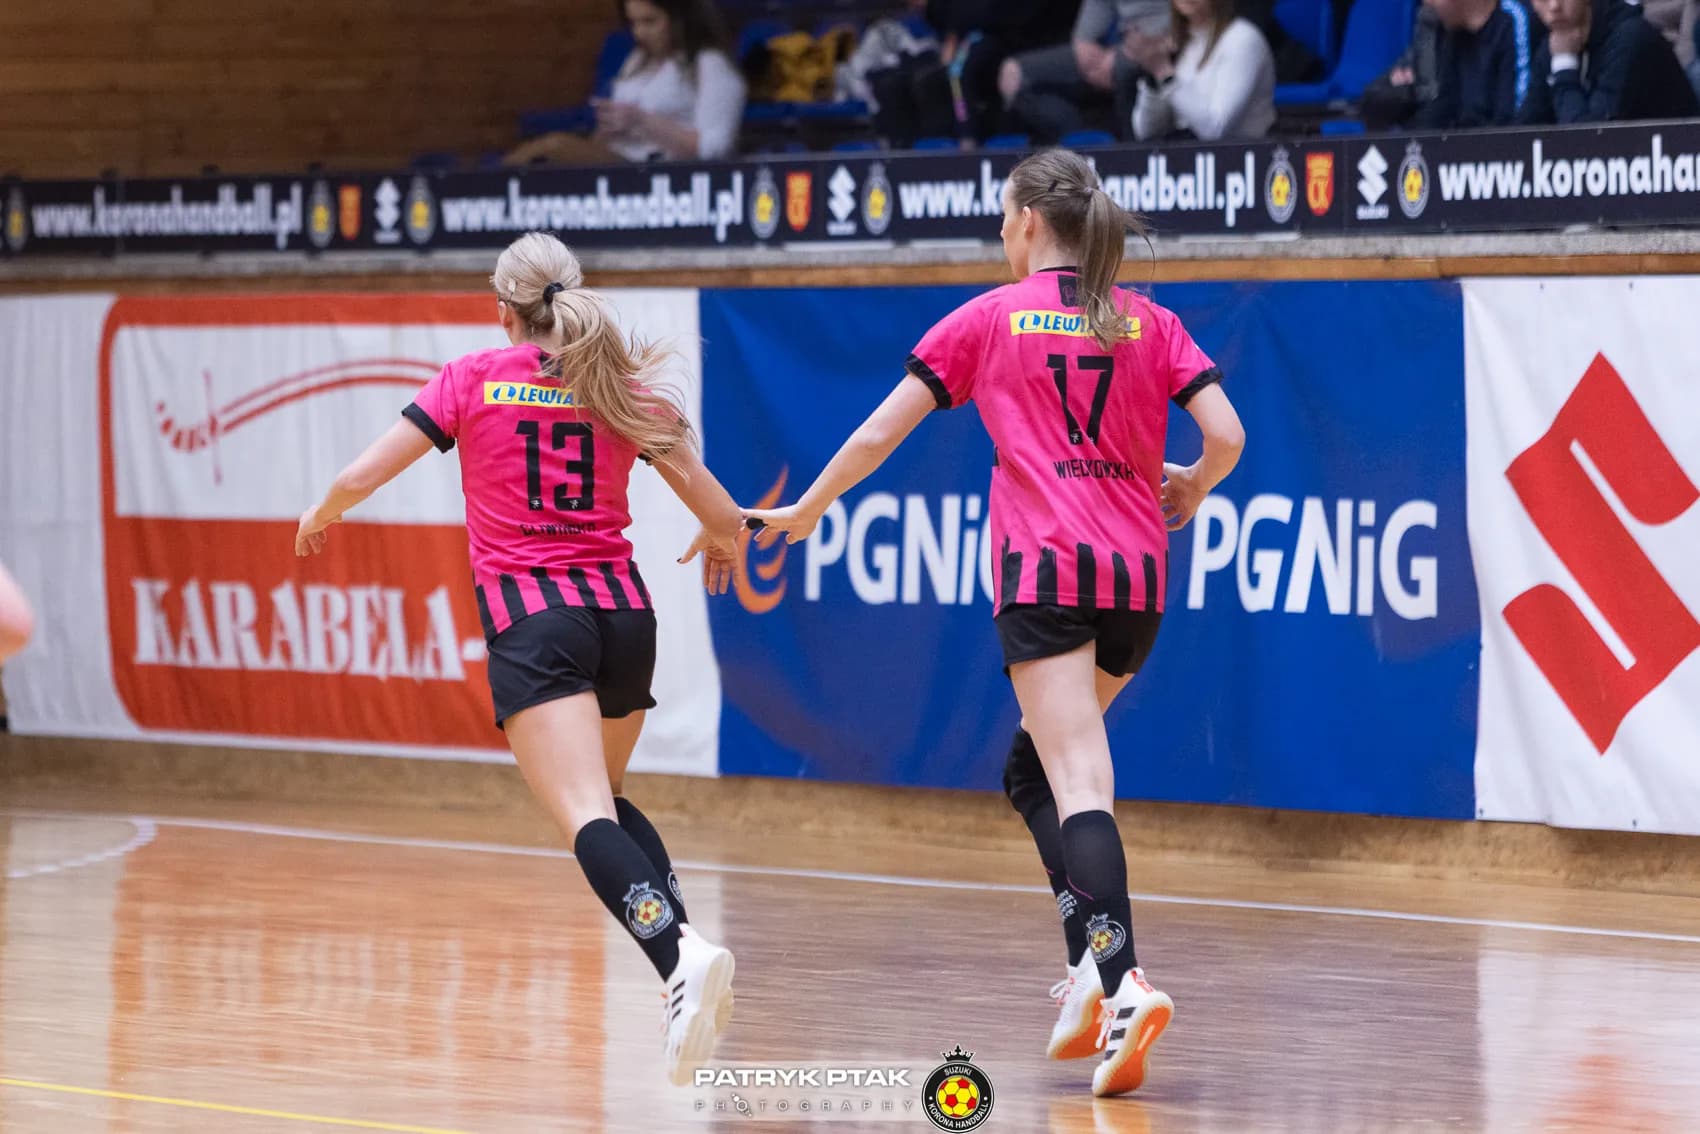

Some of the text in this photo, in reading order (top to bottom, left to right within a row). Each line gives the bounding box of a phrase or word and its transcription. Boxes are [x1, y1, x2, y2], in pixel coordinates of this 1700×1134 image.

[441, 171, 744, 243] www.koronahandball.pl
[898, 151, 1256, 227] www.kandball.pl
[518, 386, 584, 405] LEWIA
[1046, 353, 1114, 446] 17
[515, 420, 595, 511] 13
[804, 492, 994, 606] PGNi
[1186, 493, 1438, 620] PGNiG
